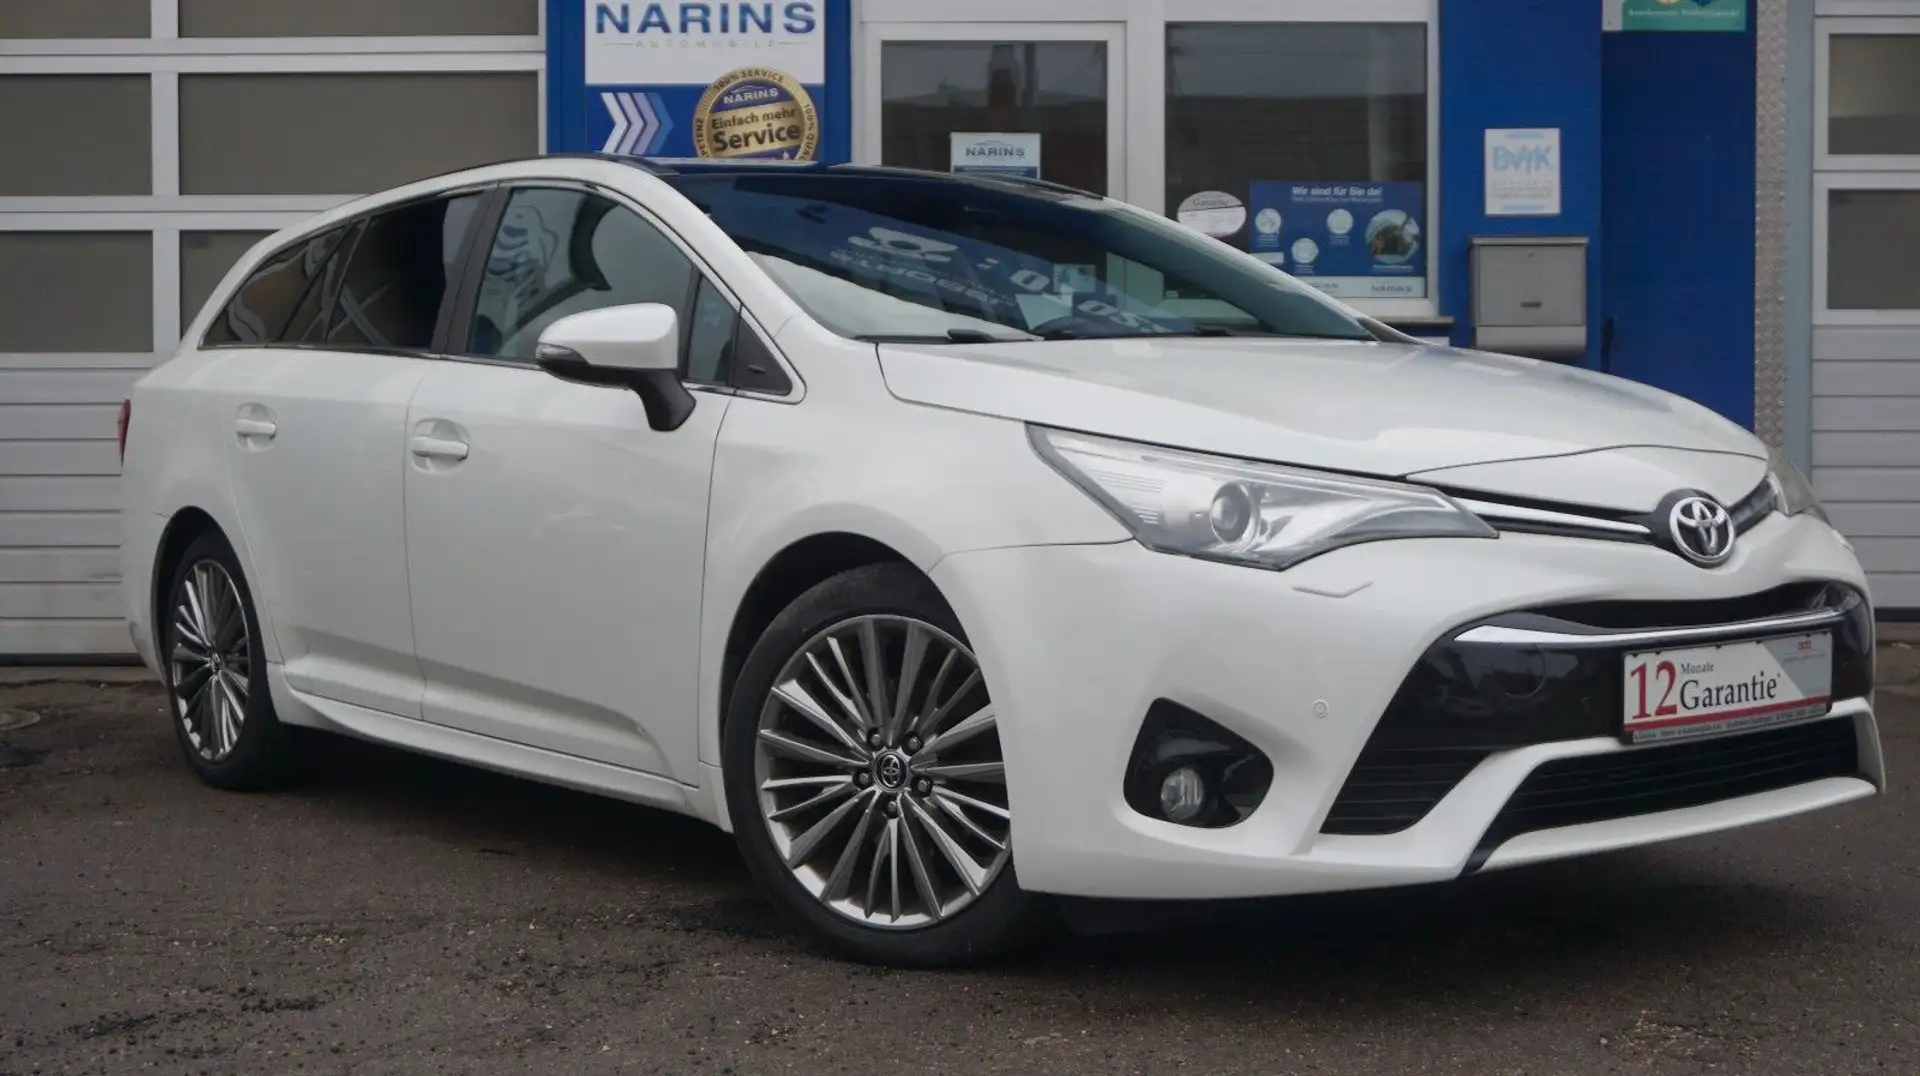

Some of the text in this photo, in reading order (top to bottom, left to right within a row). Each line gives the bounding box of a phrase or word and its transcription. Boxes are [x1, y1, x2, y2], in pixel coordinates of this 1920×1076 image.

[596, 3, 816, 34] NARINS
[740, 68, 785, 83] SERVICE
[723, 87, 779, 105] NARINS
[711, 105, 799, 130] Einfach mehr
[712, 121, 801, 153] Service
[965, 146, 1026, 157] NARINS
[1310, 185, 1332, 197] sind
[1333, 185, 1348, 197] für
[1349, 185, 1366, 198] Sie
[1681, 662, 1714, 675] Monate
[1630, 660, 1678, 719] 12
